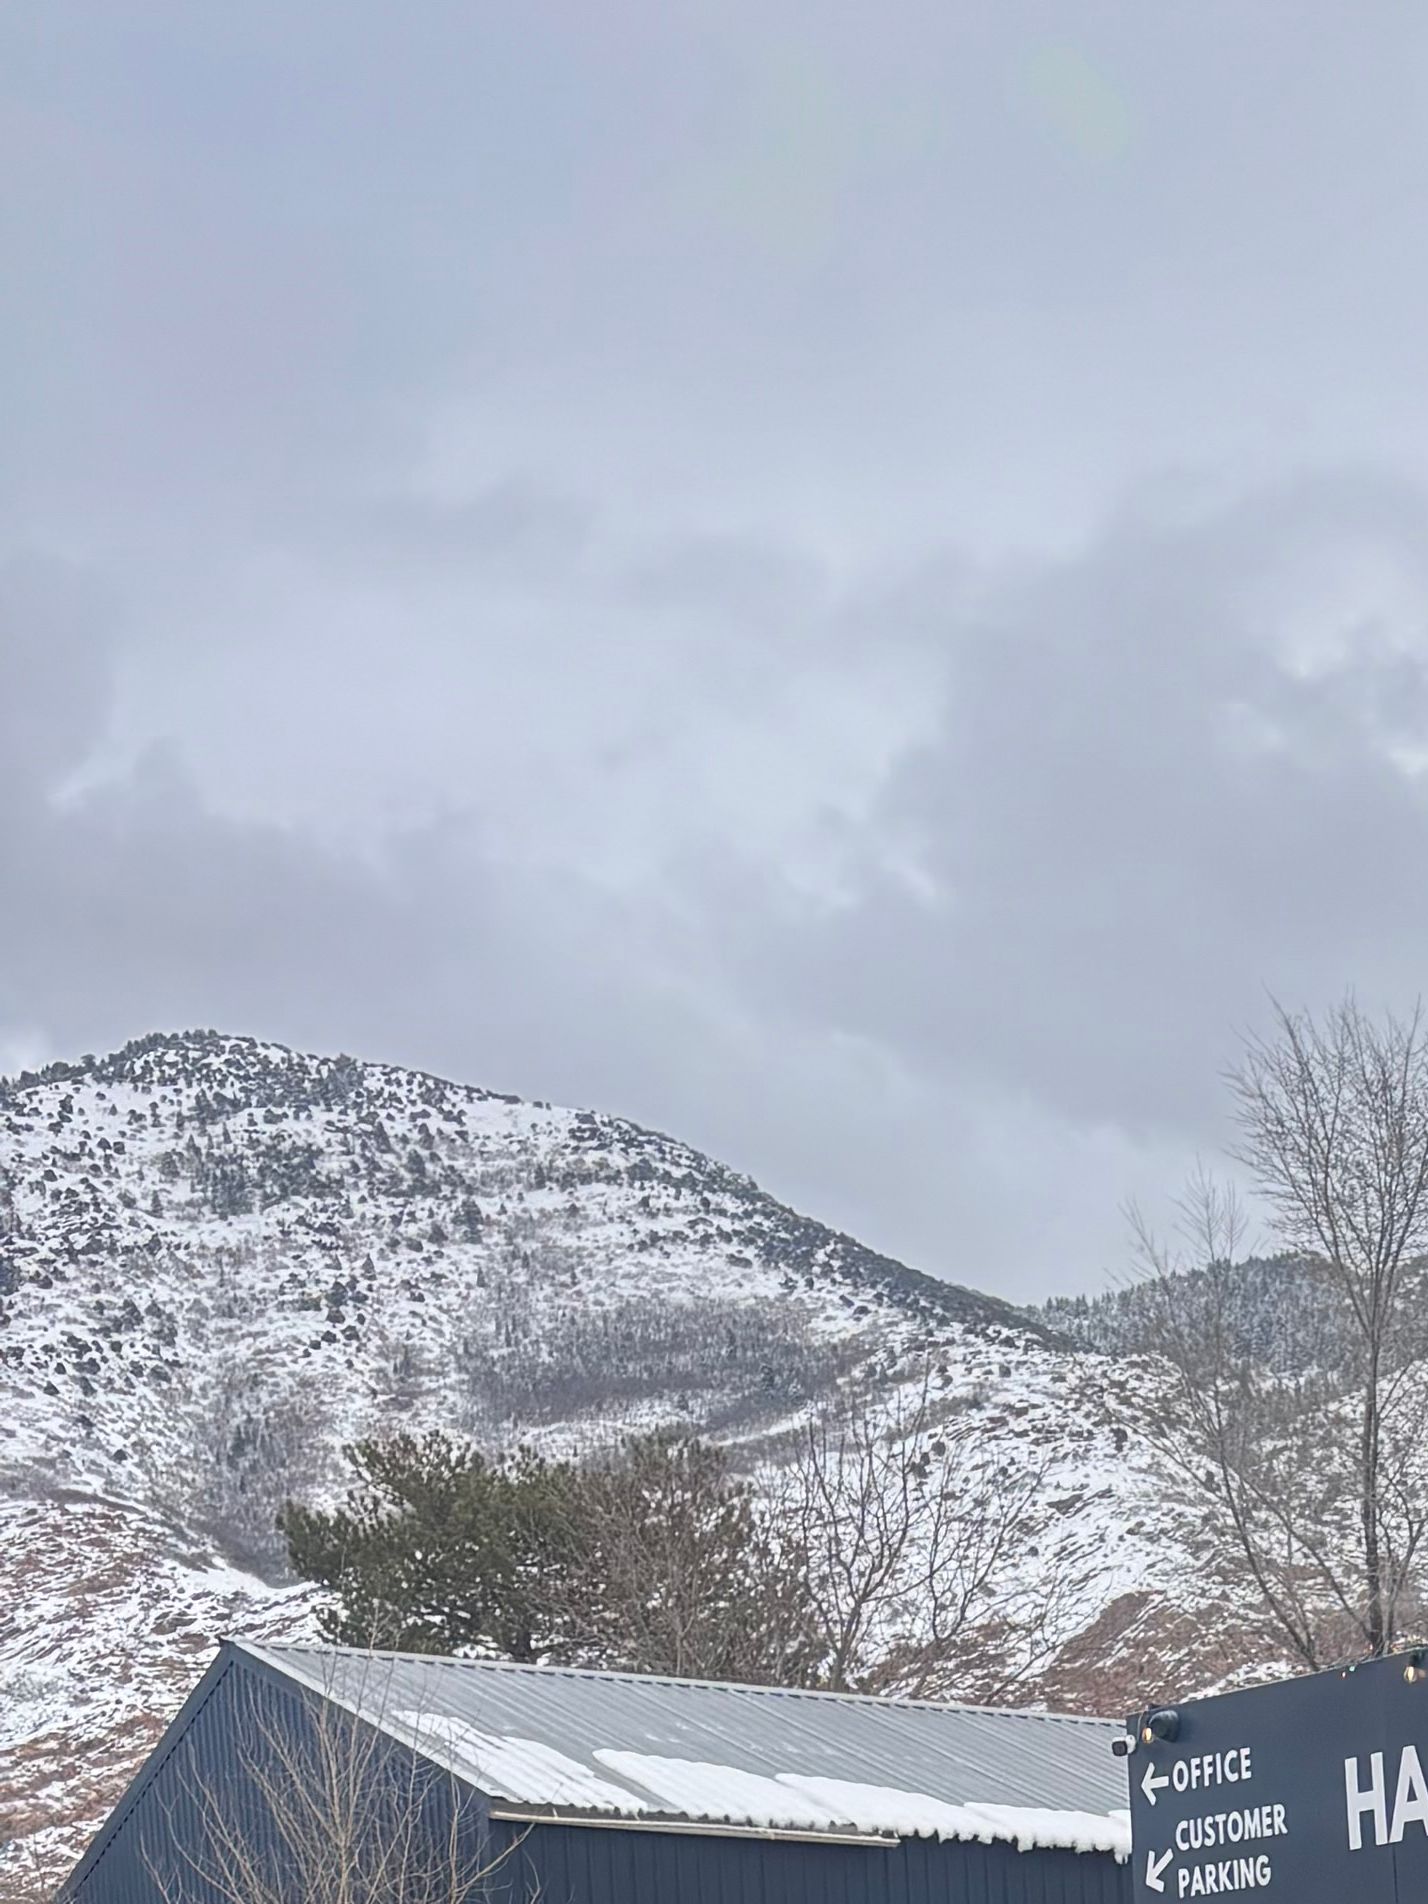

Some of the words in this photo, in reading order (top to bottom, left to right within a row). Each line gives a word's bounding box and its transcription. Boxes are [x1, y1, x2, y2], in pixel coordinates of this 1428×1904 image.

[1172, 1747, 1252, 1792] OFFICE
[1175, 1803, 1288, 1851] CUSTOMER
[1178, 1854, 1272, 1899] PARKING
